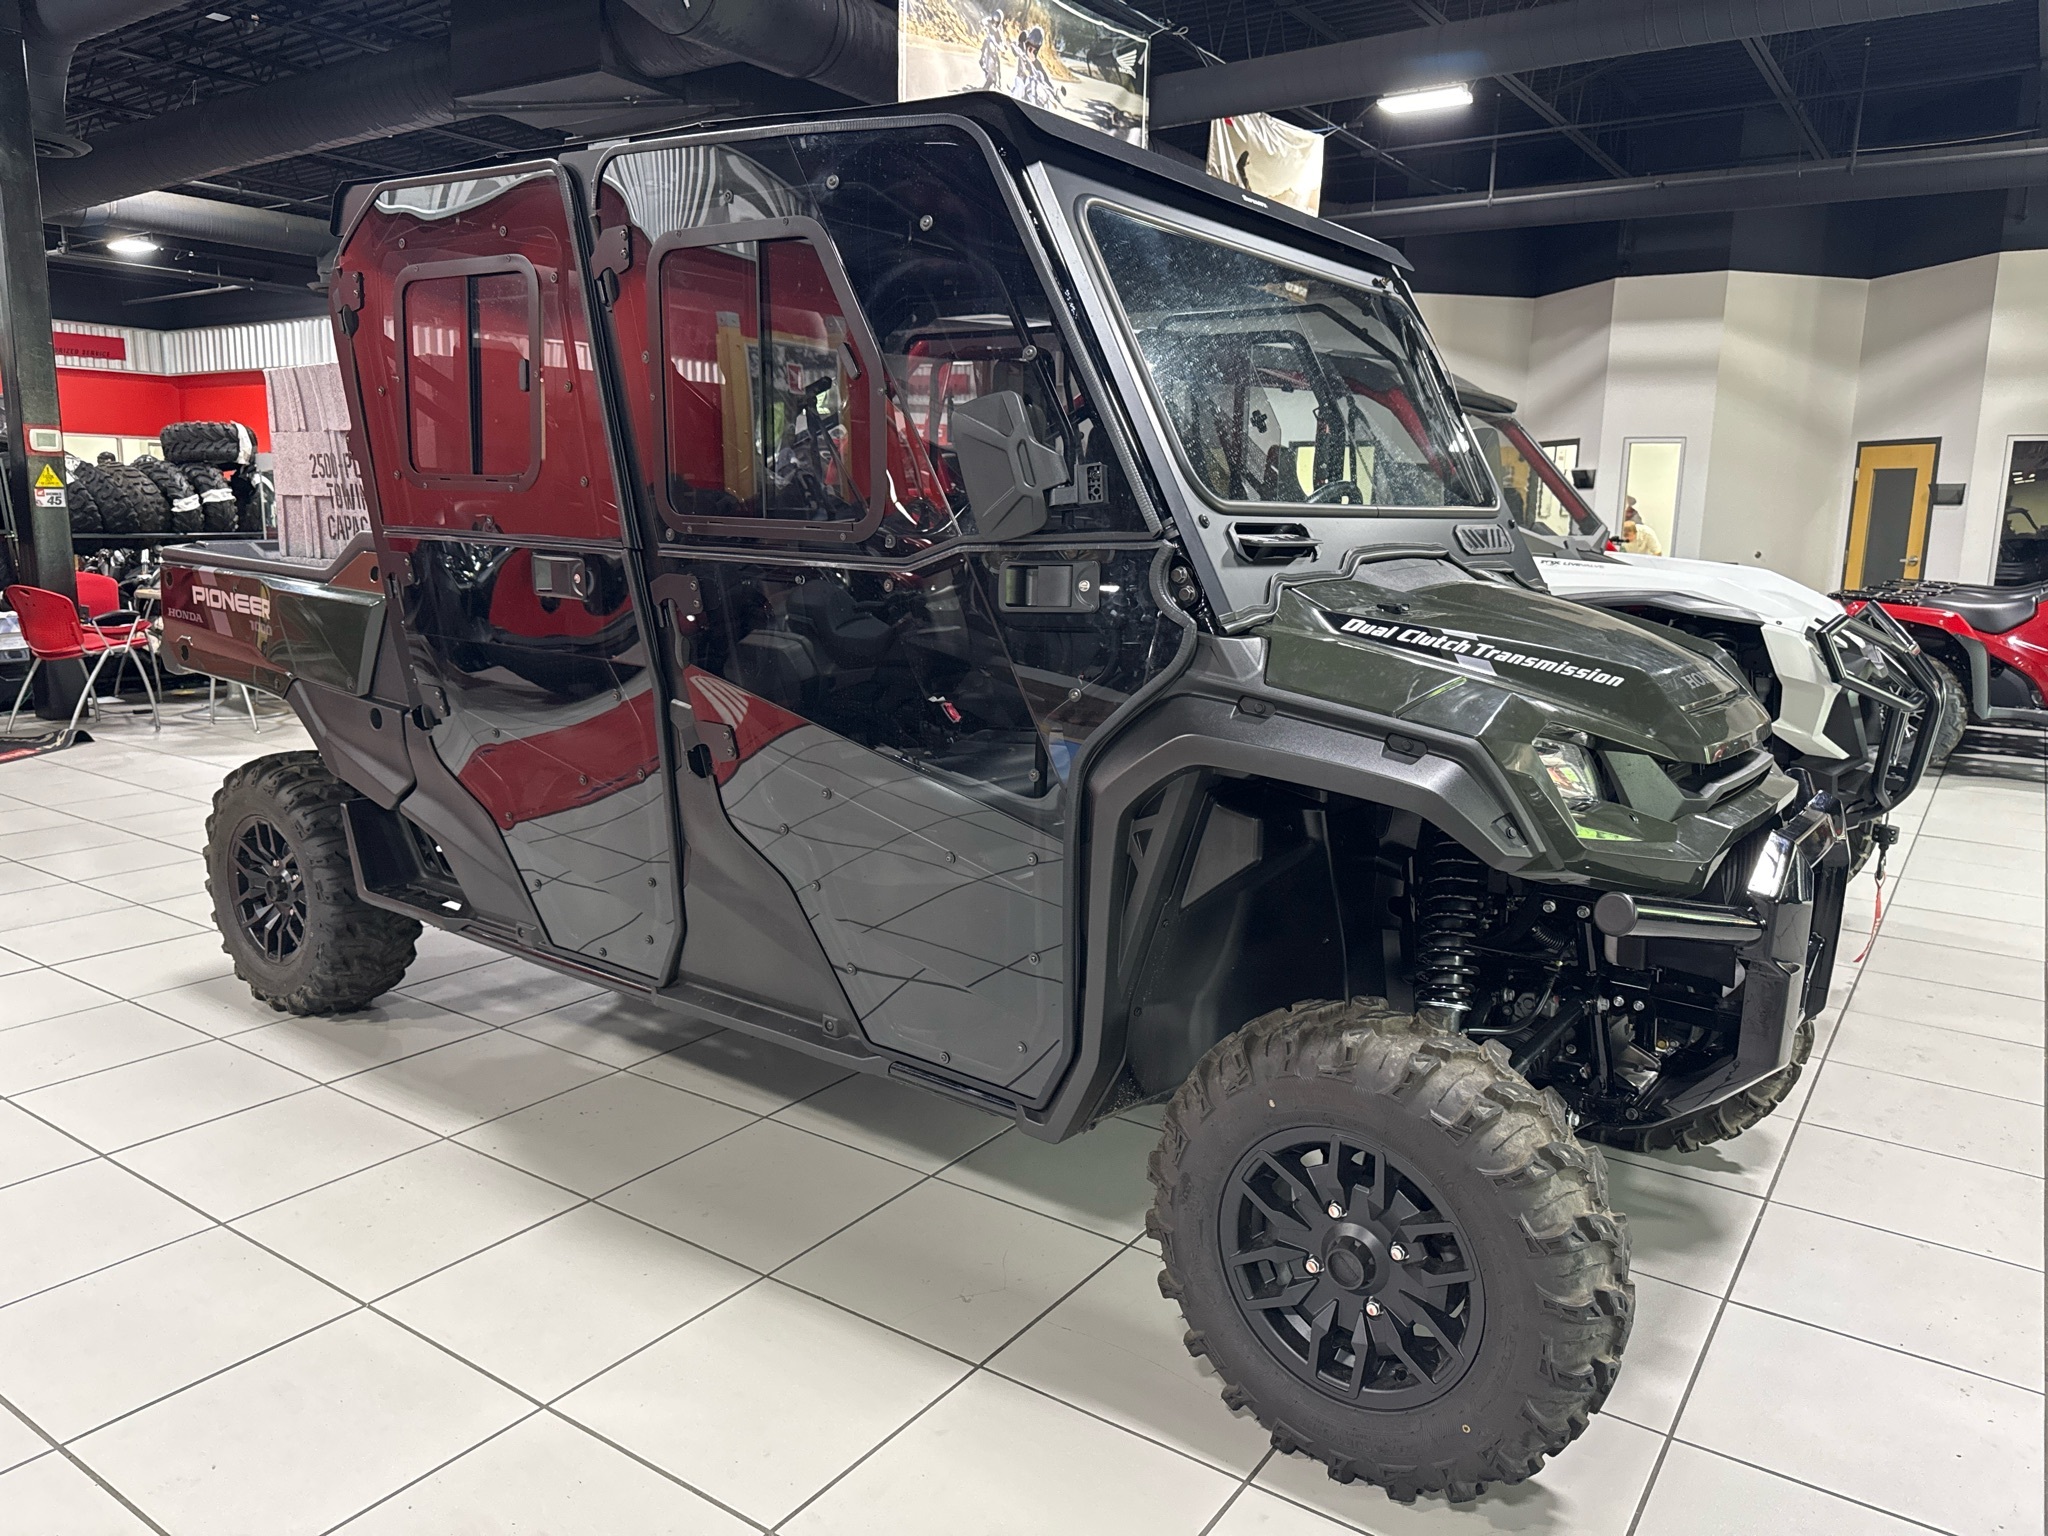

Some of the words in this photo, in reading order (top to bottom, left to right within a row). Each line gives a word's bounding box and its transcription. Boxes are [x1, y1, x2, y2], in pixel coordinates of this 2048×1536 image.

[47, 496, 62, 505] 45
[191, 585, 271, 620] PIONEER
[167, 607, 204, 623] HONDA
[249, 620, 273, 637] 1000
[1340, 618, 1399, 639] Dual
[1396, 628, 1469, 654] Clutch
[1469, 643, 1625, 688] Transmission
